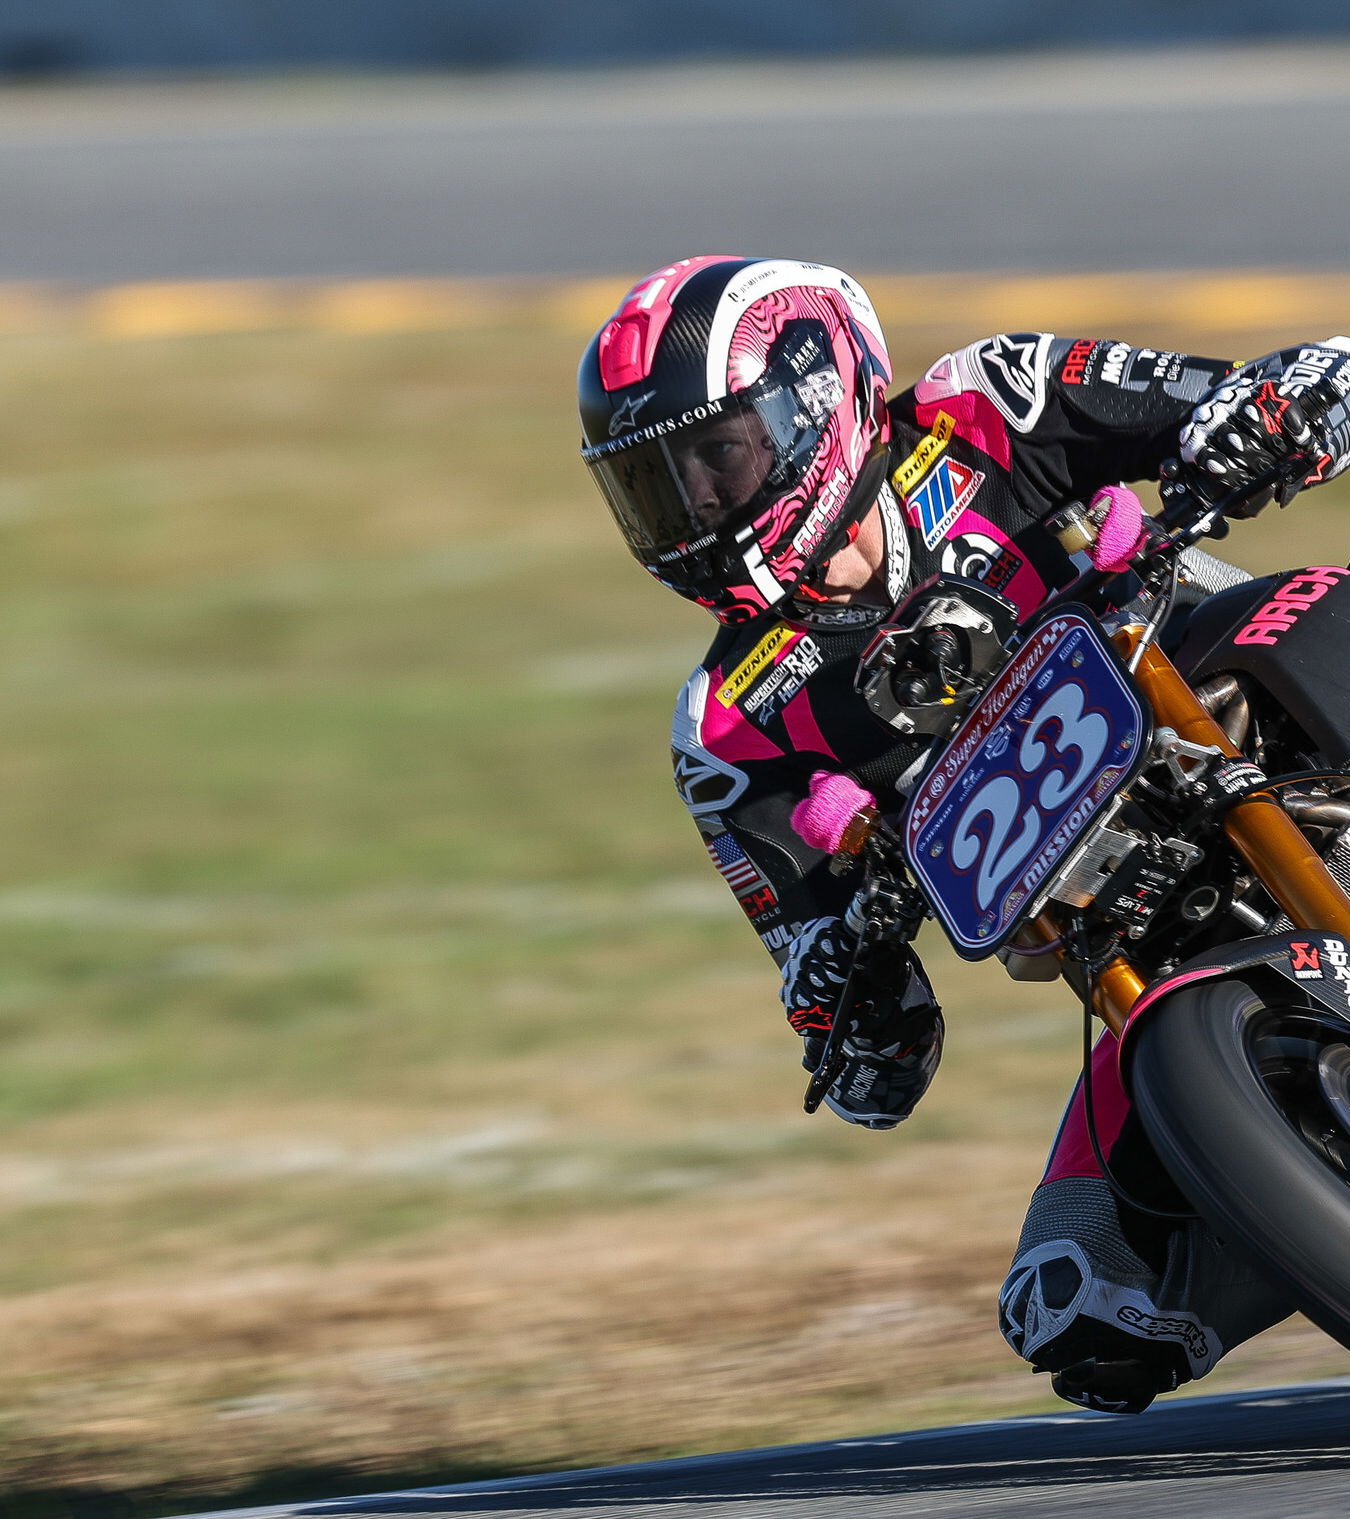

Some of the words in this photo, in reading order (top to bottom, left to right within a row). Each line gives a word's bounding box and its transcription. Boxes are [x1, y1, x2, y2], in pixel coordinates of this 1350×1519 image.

[1062, 340, 1097, 385] ARC
[903, 419, 948, 482] DUNLOP
[927, 472, 985, 549] MOTOAMERICA
[733, 627, 785, 688] DUNLOP
[778, 647, 823, 703] HELMET
[786, 636, 817, 674] R10
[946, 721, 983, 778] Super
[981, 643, 1045, 726] Hooligan
[952, 683, 1109, 910] 23
[742, 886, 777, 918] CH
[847, 1064, 879, 1102] RACING
